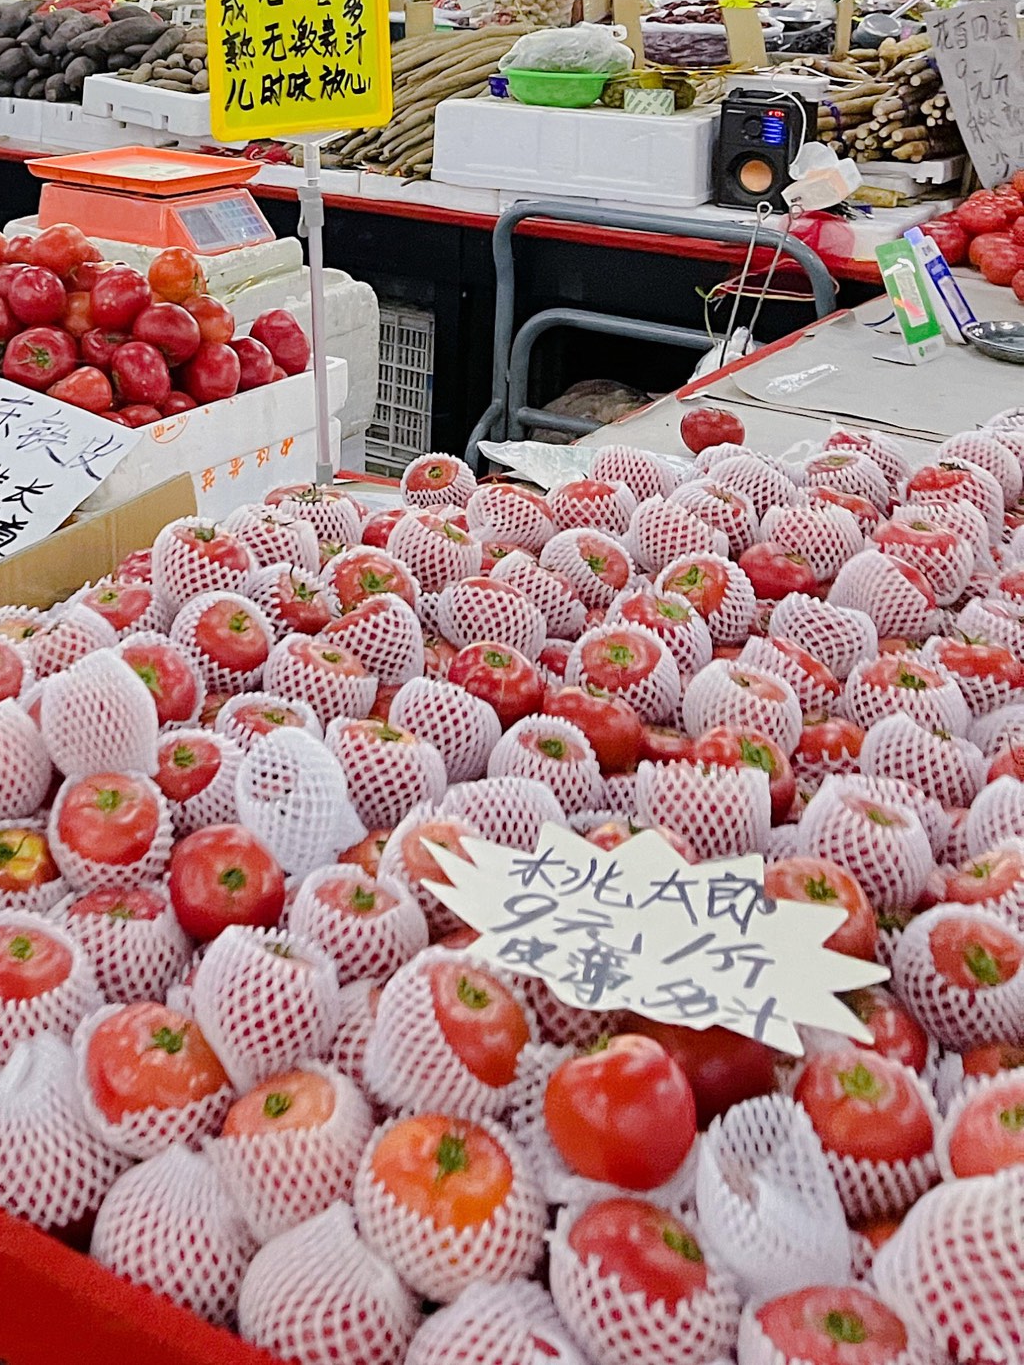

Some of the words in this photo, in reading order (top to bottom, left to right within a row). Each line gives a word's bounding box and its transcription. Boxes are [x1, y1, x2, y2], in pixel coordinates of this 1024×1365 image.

[262, 13, 341, 62] 无激素
[508, 846, 777, 935] 桃太郎
